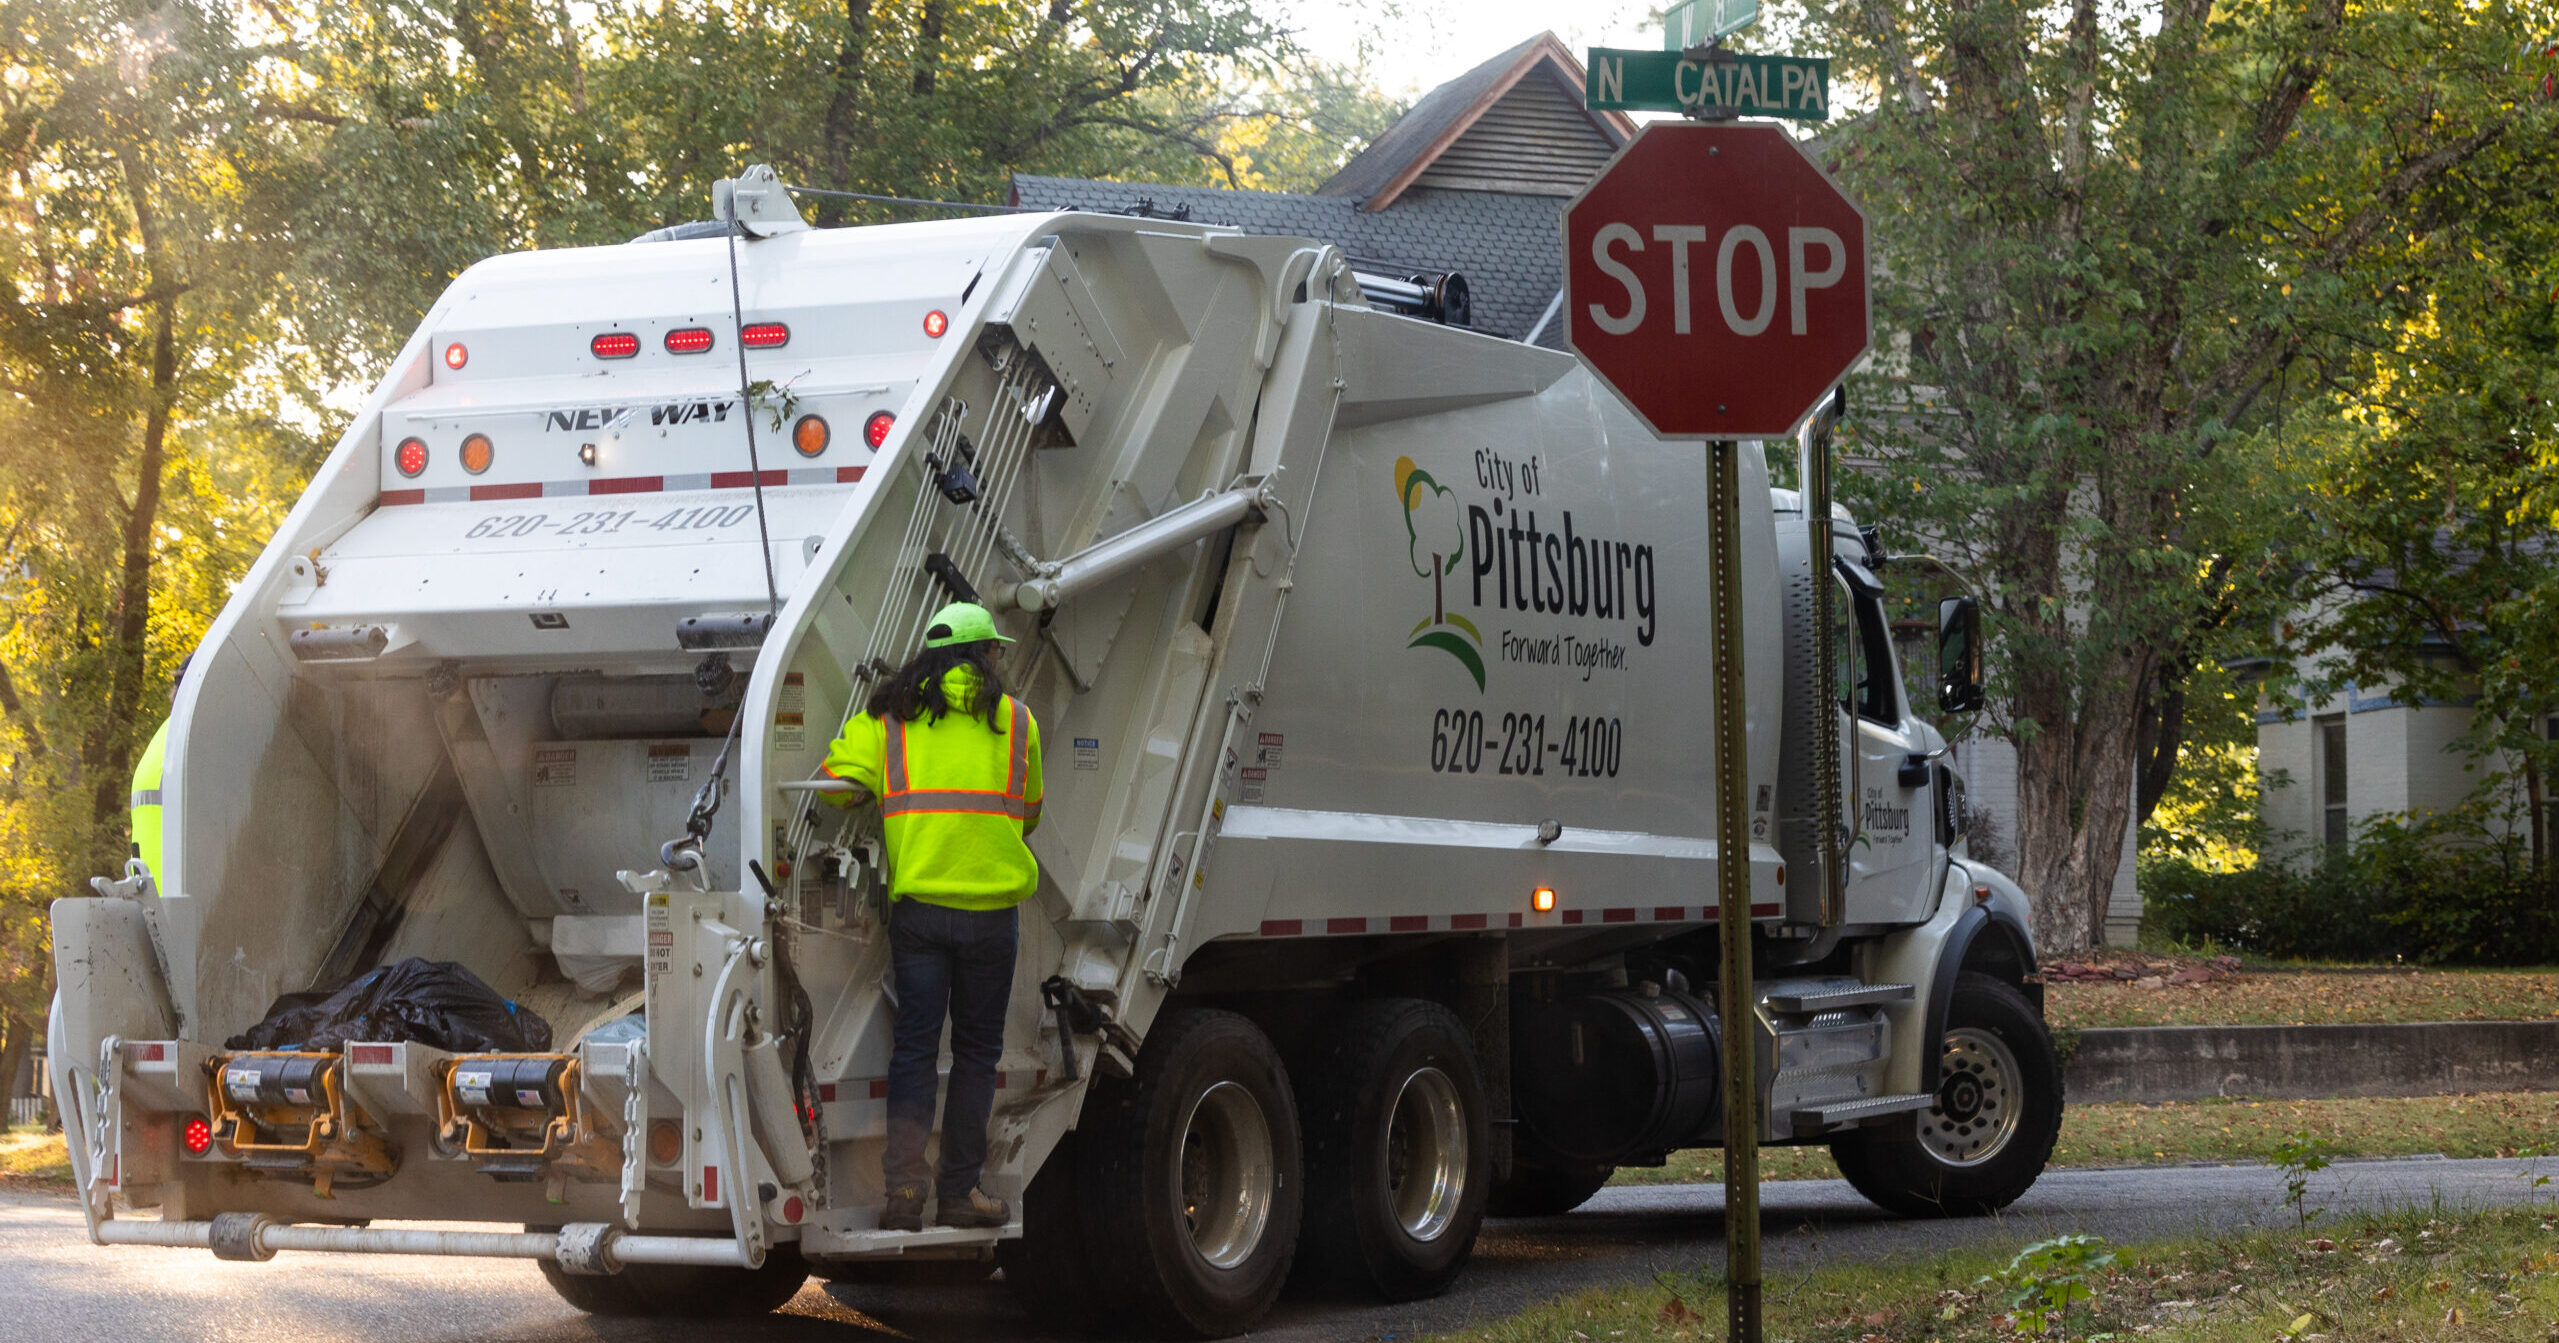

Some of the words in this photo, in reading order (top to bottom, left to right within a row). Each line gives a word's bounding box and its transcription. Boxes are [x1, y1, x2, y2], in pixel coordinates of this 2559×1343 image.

[1681, 3, 1694, 48] W
[1598, 57, 1623, 102] N
[1675, 60, 1825, 111] CATALPA
[1588, 221, 1847, 336] STOP
[546, 407, 640, 433] NEW
[650, 401, 735, 427] WAY
[1475, 447, 1513, 501] City
[1521, 456, 1540, 496] of
[465, 505, 755, 539] 620-231-4100
[1468, 497, 1656, 647] Pittsburg
[1502, 630, 1559, 665] Forward
[1564, 635, 1628, 682] Together.
[1431, 708, 1622, 778] 620-231-4100
[1865, 800, 1909, 837] Pittsburg
